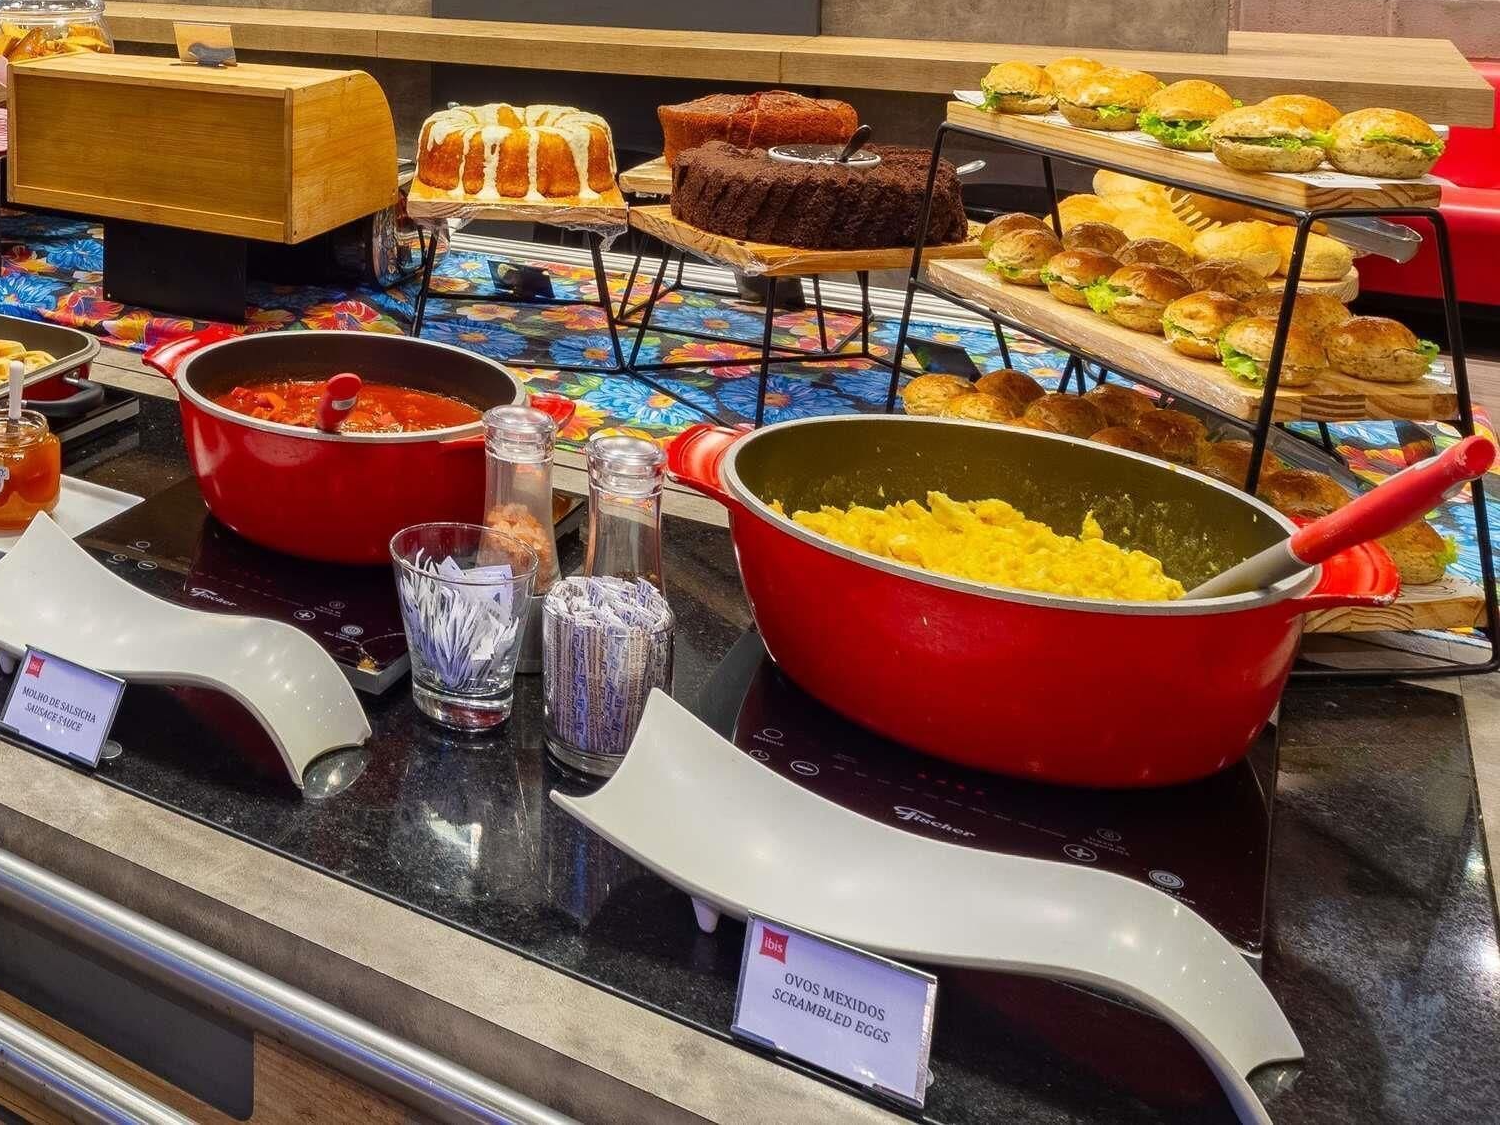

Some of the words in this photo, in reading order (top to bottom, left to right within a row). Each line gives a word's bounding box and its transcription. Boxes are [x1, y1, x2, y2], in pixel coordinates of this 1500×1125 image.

[22, 686, 49, 704] MOLHO
[49, 696, 60, 708] DE
[60, 701, 96, 724] SALSICHA
[25, 702, 58, 723] SAUSAGE
[57, 716, 83, 732] SAUCE
[893, 805, 977, 837] Fischer
[764, 936, 784, 953] ibis
[784, 973, 820, 996] OVOS
[823, 987, 886, 1021] MEXIDOS
[772, 988, 852, 1028] SCRAMBLED
[855, 1020, 891, 1044] EGGS
